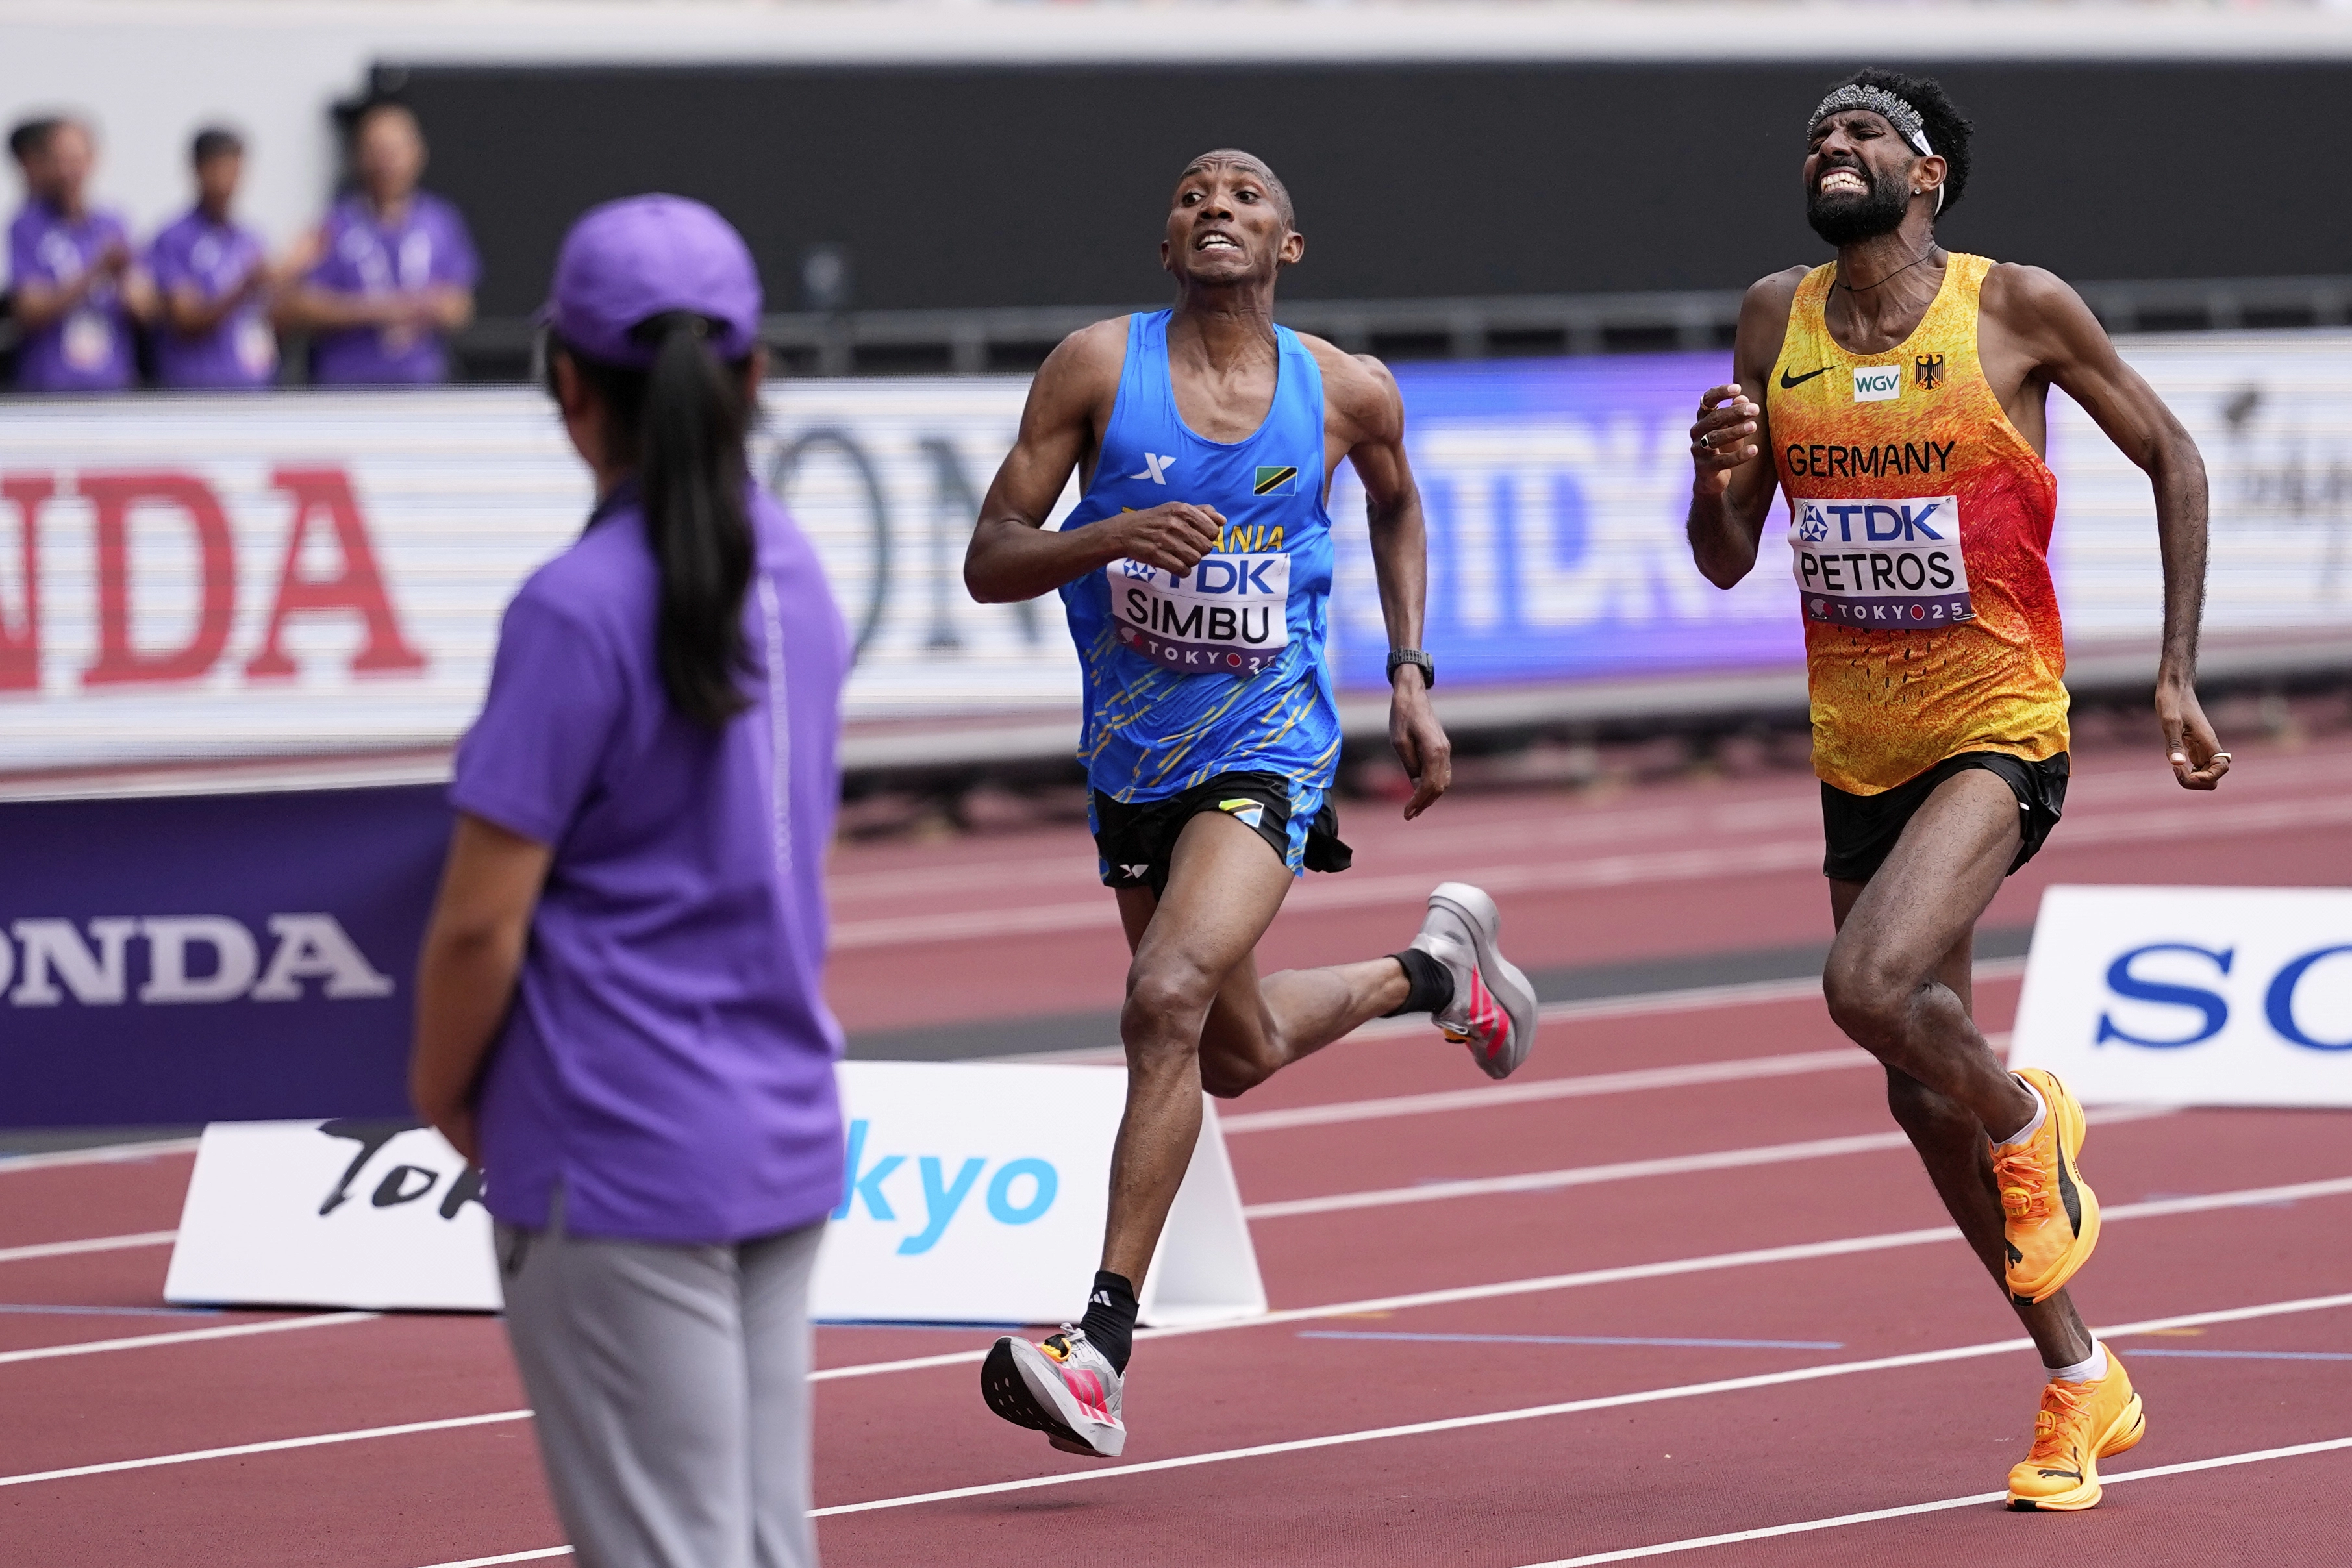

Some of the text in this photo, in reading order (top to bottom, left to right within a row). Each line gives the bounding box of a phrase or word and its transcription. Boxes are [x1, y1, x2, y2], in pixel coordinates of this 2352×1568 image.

[1855, 373, 1899, 392] WGV
[1786, 440, 1955, 478] GERMANY
[1827, 503, 1944, 542] TDK
[1800, 551, 1955, 591] PETROS
[1125, 588, 1270, 644] SIMBU
[0, 912, 394, 1006] NDA
